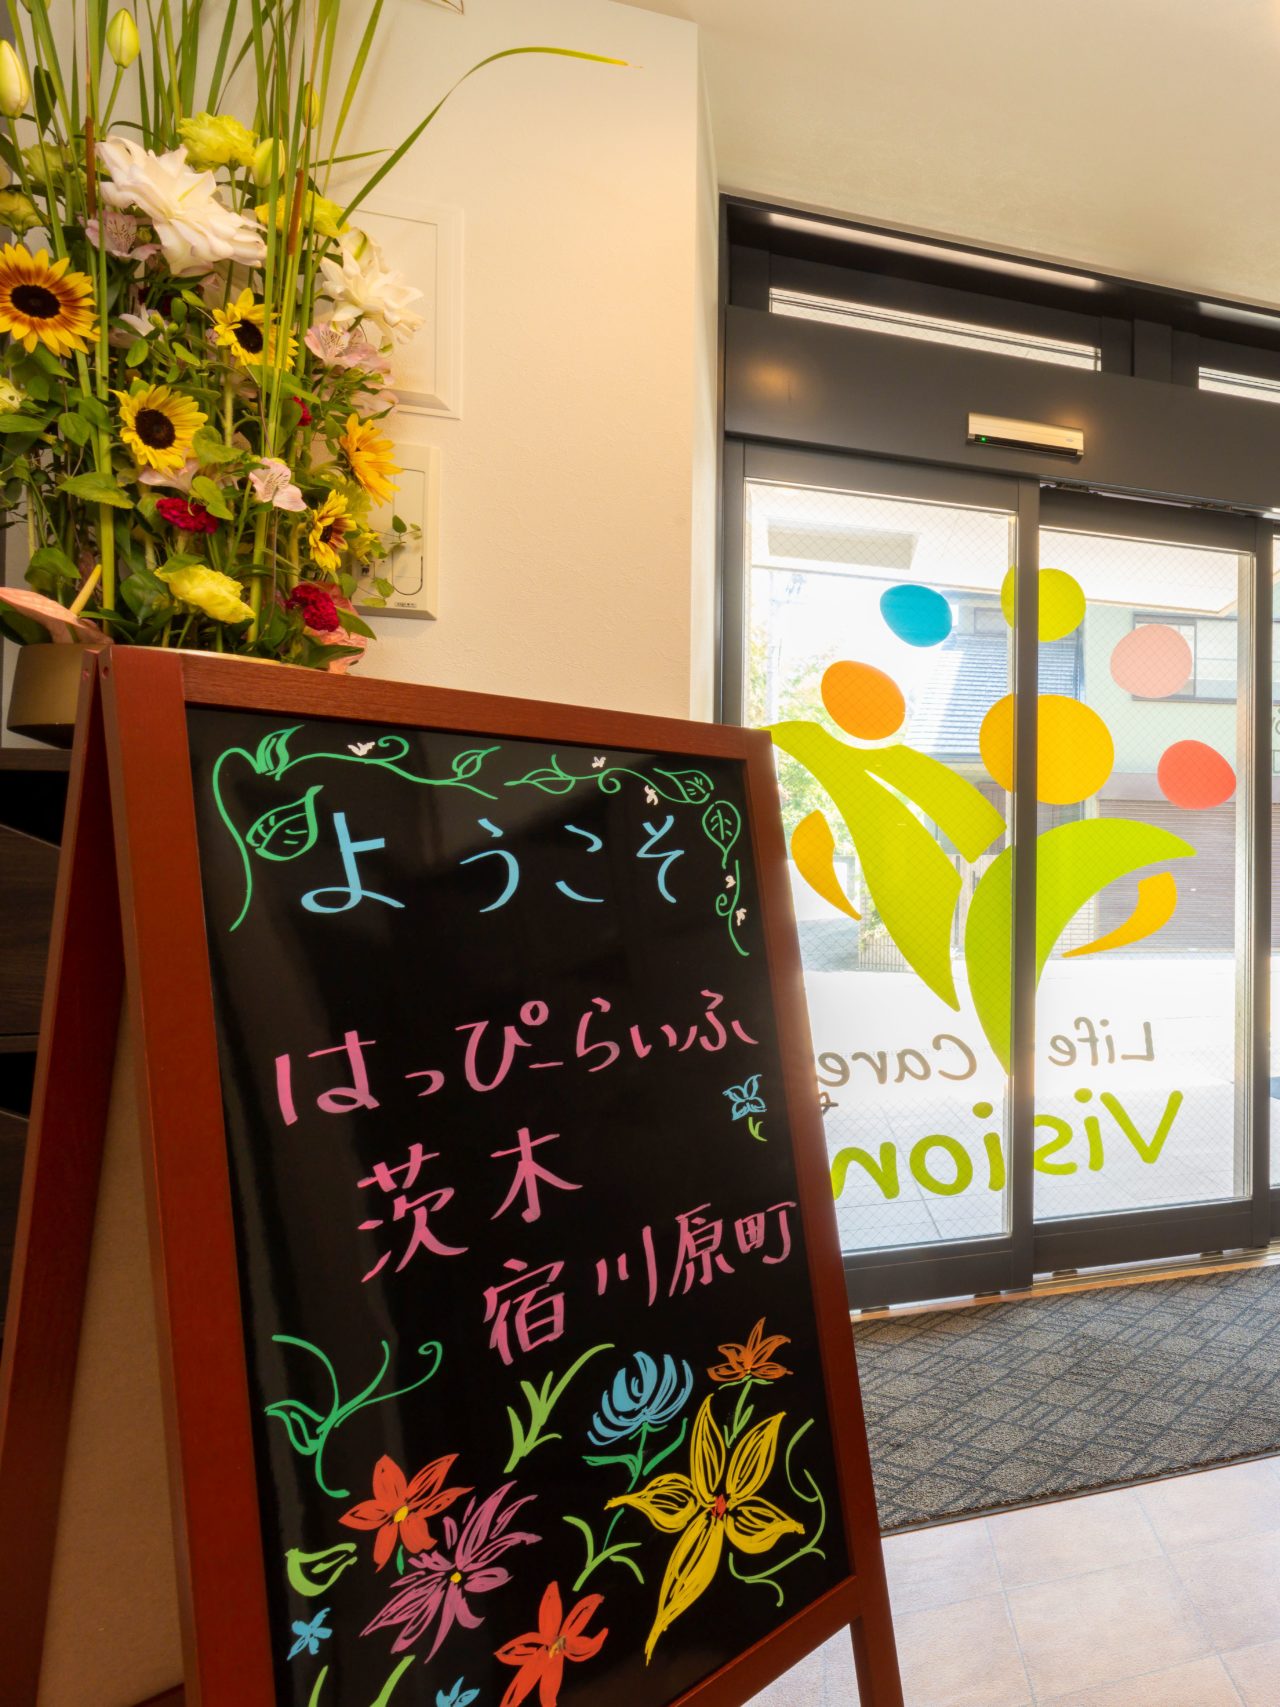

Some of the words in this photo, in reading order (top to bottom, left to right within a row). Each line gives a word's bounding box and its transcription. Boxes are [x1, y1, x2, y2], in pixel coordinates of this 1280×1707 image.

[301, 811, 685, 914] ようこそ
[275, 989, 759, 1126] はっぴーらいふ
[356, 1127, 584, 1284] 茨木
[482, 1201, 797, 1367] 宿川原町
